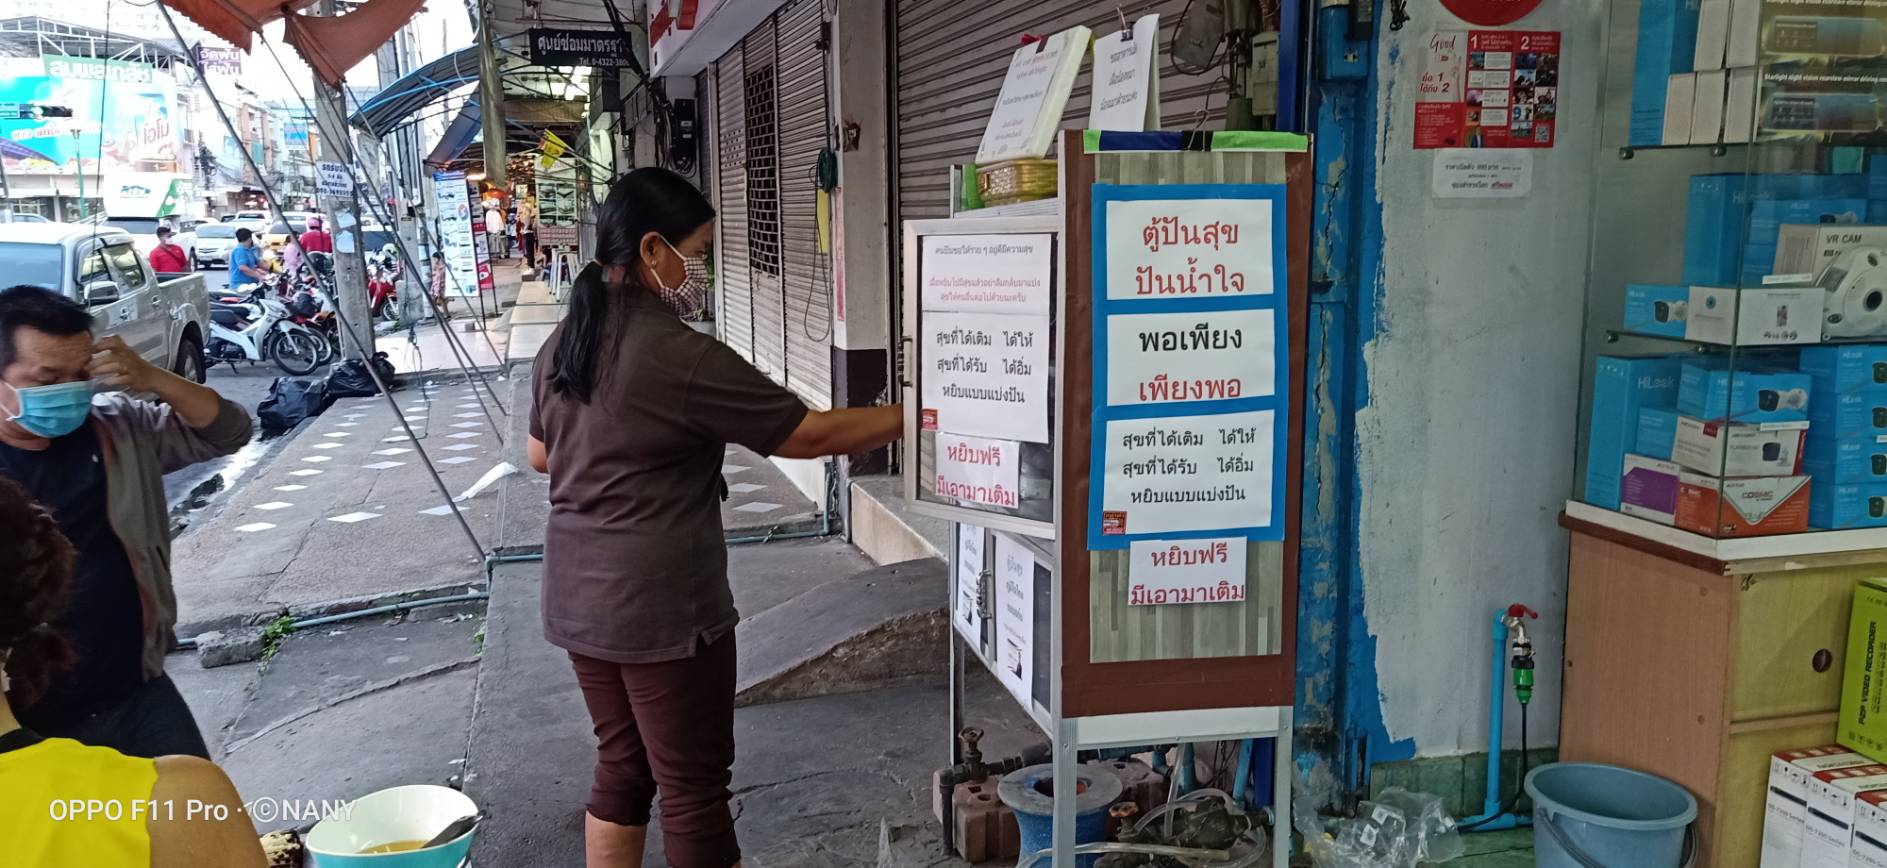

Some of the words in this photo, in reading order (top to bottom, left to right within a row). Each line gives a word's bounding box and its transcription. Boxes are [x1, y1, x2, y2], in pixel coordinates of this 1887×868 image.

[1471, 35, 1478, 49] 1
[1521, 36, 1530, 50] 2
[1441, 83, 1450, 93] 2
[1143, 216, 1239, 252] ตู้ปันสุข
[1826, 233, 1840, 245] VR
[1842, 233, 1863, 244] CAM
[1136, 257, 1245, 295] ปันน้ำใจ
[936, 325, 993, 347] สุขที่ได้เติม
[1003, 331, 1033, 348] ได้ให้
[1139, 322, 1242, 352] พอเพียง
[937, 352, 987, 374] สุขที่ได้รับ
[1003, 356, 1032, 376] ได้อิ่ม
[942, 383, 1026, 404] หยิบแบบแบ่งปัน
[1139, 373, 1241, 402] เพียงพอ
[1123, 427, 1203, 450] สุขที่ได้เติม
[1218, 427, 1256, 445] ได้ให้
[947, 442, 1001, 468] หยิบฟรี
[1123, 455, 1197, 478] สุขที่ได้รับ
[1217, 452, 1254, 473] ได้อิ่ม
[937, 476, 1016, 506] มีเอามาเติม
[1131, 485, 1245, 504] หยิบแบบแบ่งปัน
[1151, 542, 1228, 567] หยิบฟรี
[1131, 580, 1245, 606] มีเอามาเติม
[1865, 621, 1876, 672] RECORDER
[1862, 674, 1870, 702] VIDEO
